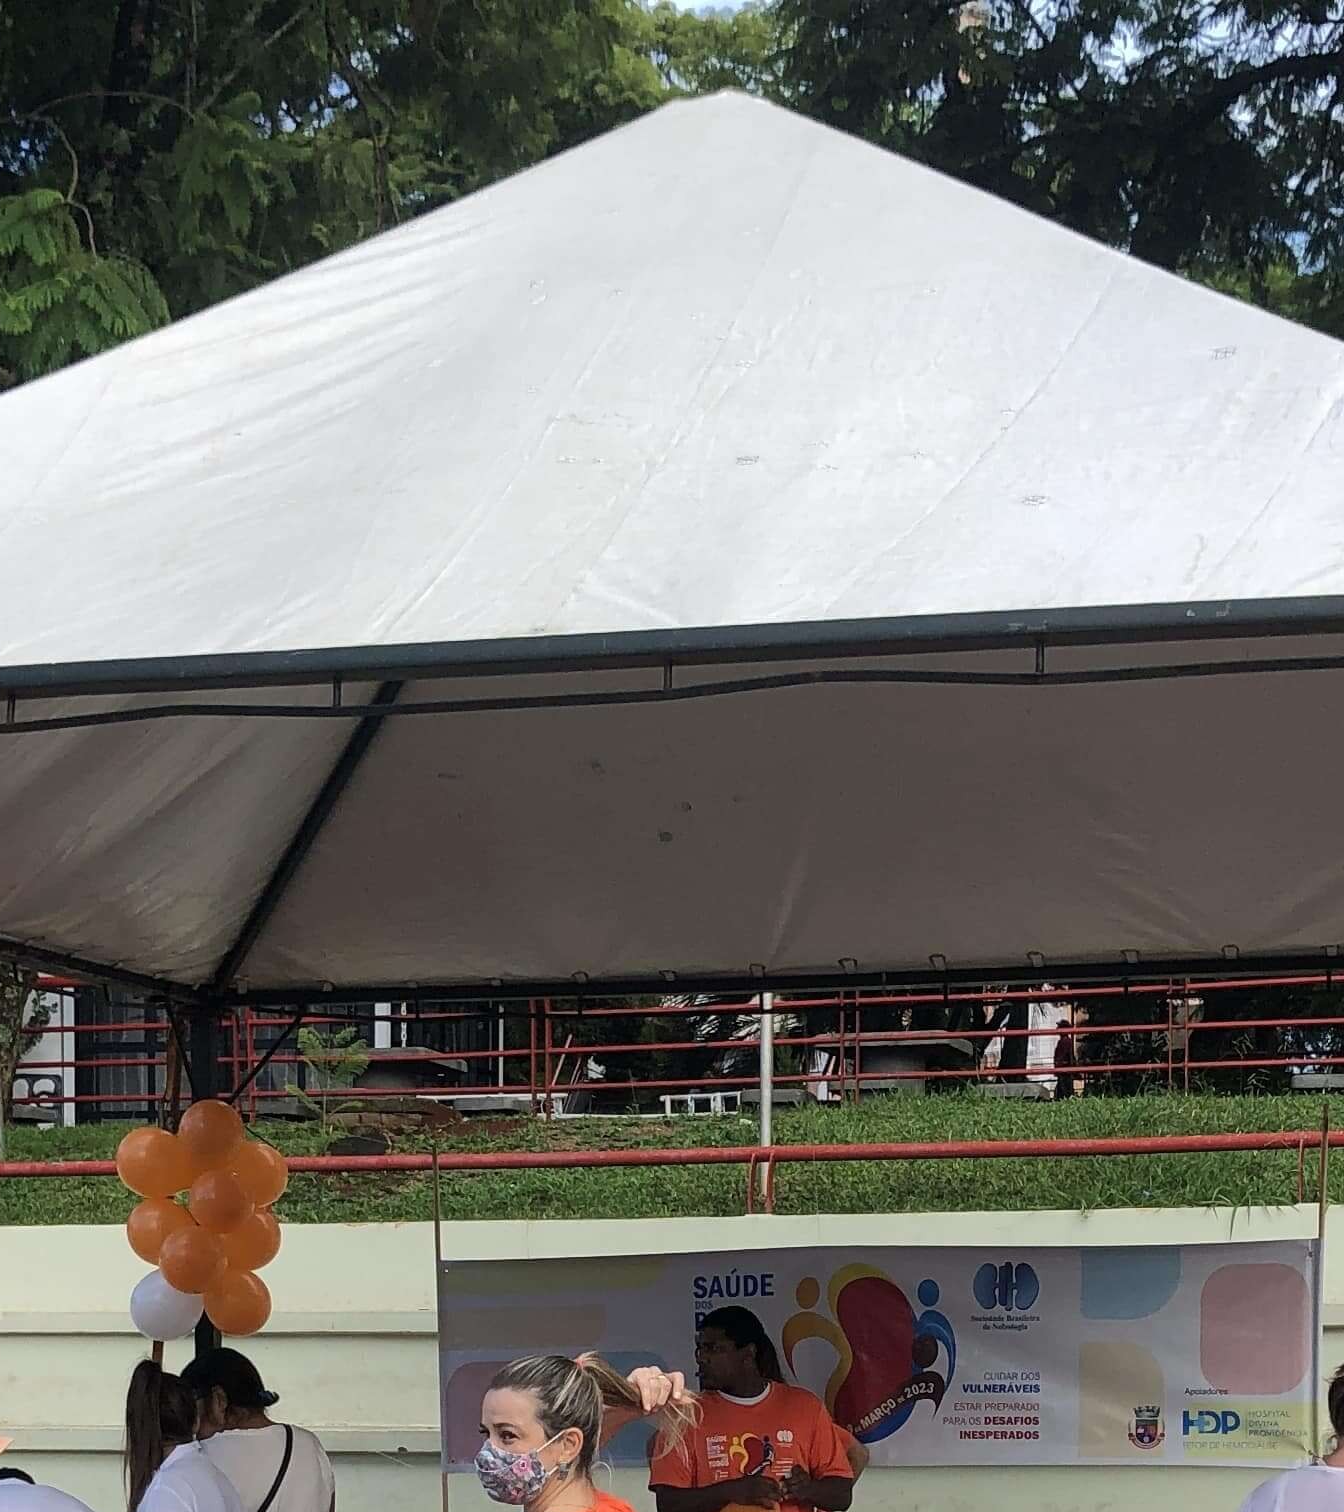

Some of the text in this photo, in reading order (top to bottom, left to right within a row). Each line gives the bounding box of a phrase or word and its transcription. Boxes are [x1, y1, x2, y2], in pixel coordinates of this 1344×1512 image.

[693, 1268, 774, 1299] SAÚDE
[983, 1371, 1041, 1381] CUIDAR DOS
[962, 1381, 1041, 1394] VULNERÁVEIS
[860, 1398, 897, 1429] MARÇO
[905, 1383, 936, 1399] 2023
[954, 1402, 1040, 1411] ESTAR PREPARADO
[1248, 1410, 1291, 1418] HOSPITAL
[943, 1416, 1040, 1425] PARA OS DESAFIOS
[1182, 1410, 1241, 1436] HDP
[1248, 1420, 1279, 1428] DIVINA
[959, 1430, 1040, 1440] INESPERADOS
